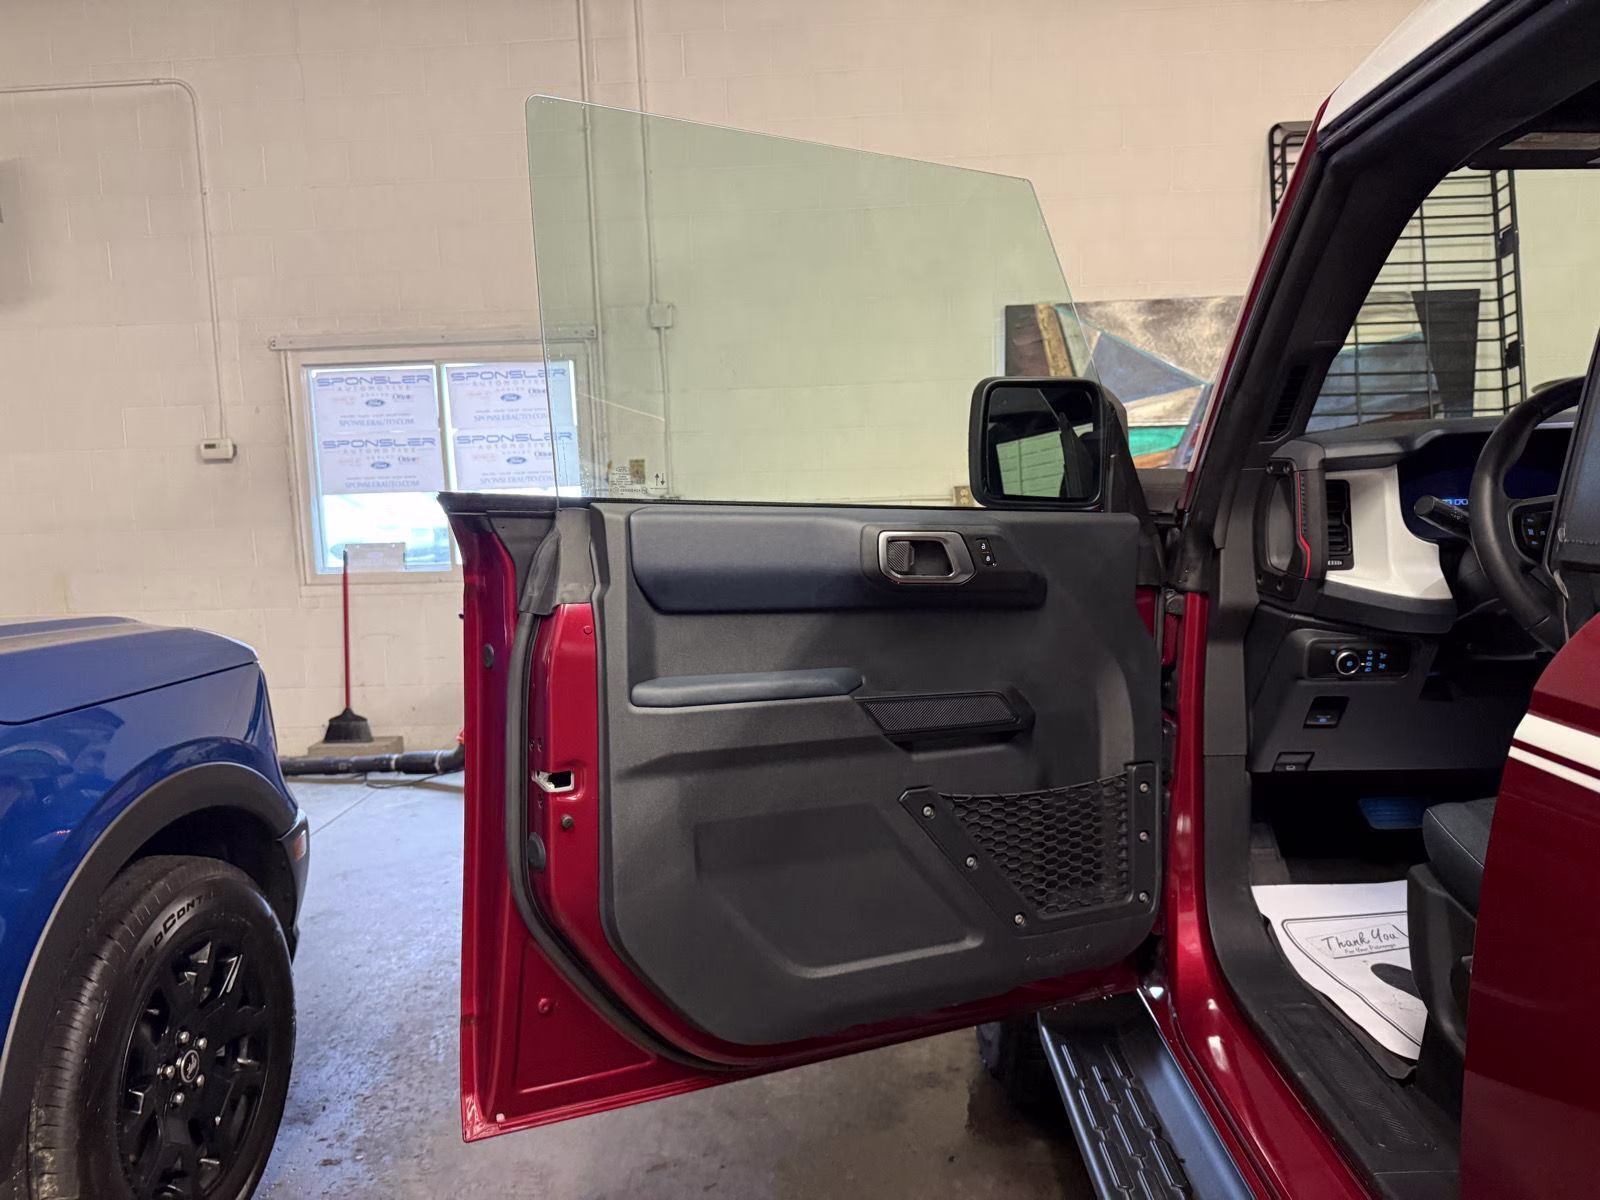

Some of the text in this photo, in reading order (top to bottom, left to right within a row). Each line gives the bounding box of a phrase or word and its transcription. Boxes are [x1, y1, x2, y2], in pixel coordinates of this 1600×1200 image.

[317, 374, 431, 387] SPONSLER
[450, 368, 567, 381] SPONSLER
[322, 437, 436, 449] SPONSLER
[456, 431, 573, 444] SPONSLER
[1321, 927, 1398, 951] Thank You
